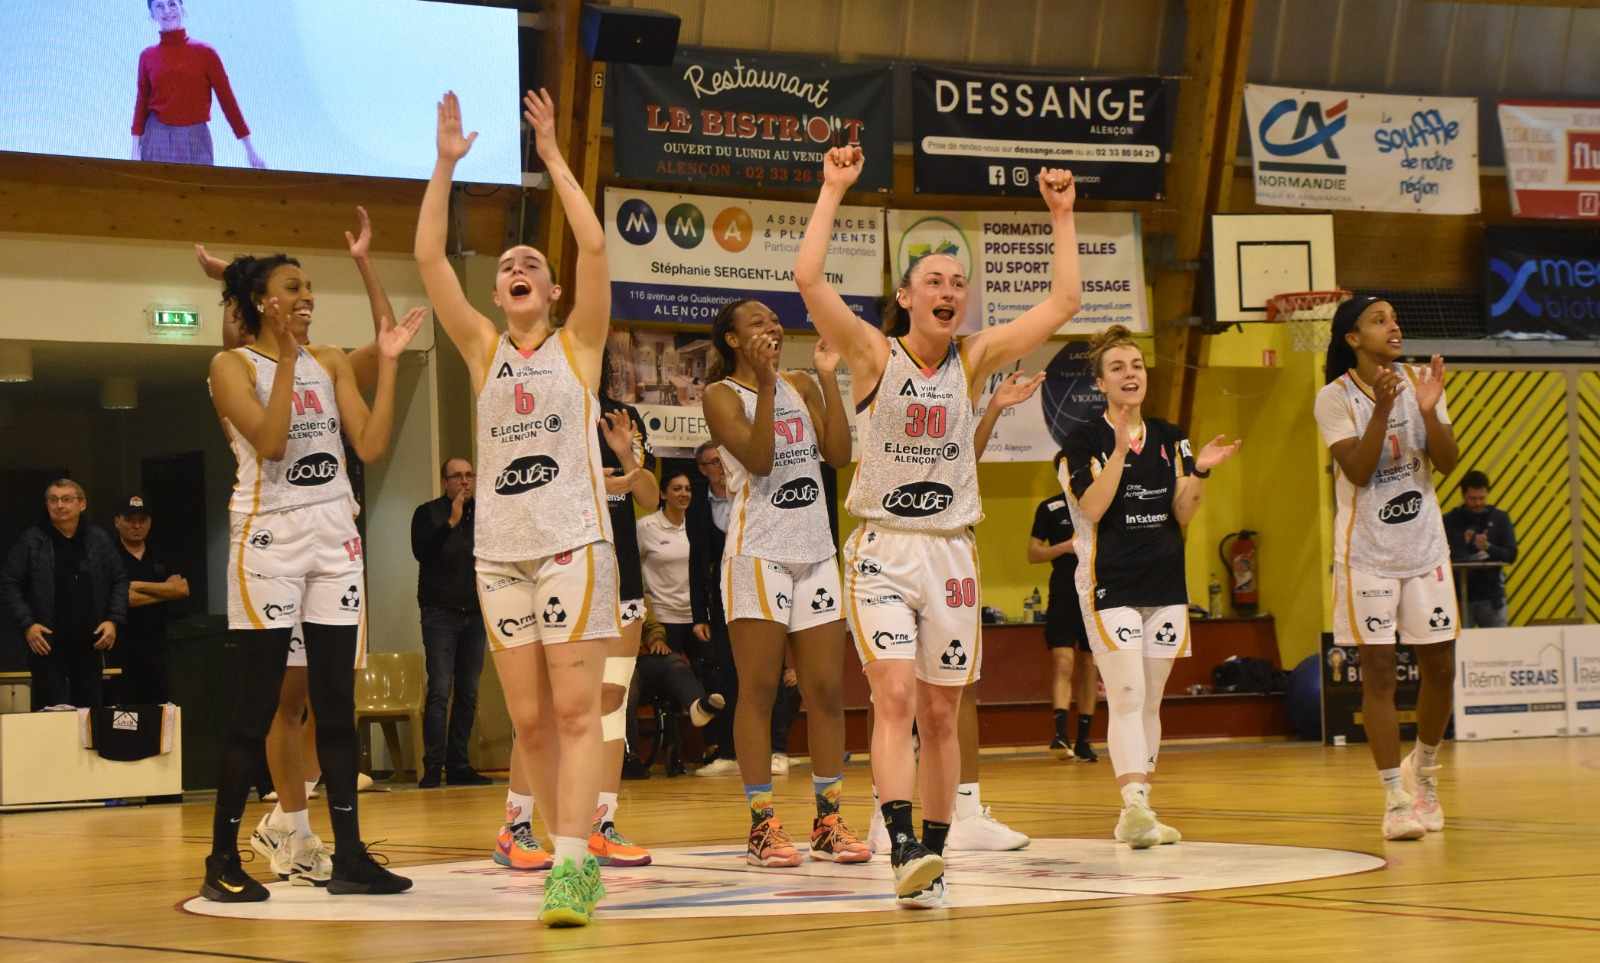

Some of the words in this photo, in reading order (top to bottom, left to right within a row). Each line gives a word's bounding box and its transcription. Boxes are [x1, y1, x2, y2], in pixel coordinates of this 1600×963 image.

[684, 59, 829, 108] Restaurant
[935, 79, 1145, 122] DESSANGE
[647, 104, 692, 134] LE
[1381, 112, 1392, 124] Le
[1090, 125, 1133, 136] ALENÇON
[1375, 109, 1459, 153] souffle
[664, 142, 712, 156] OUVERT
[716, 146, 732, 157] DU
[735, 147, 770, 160] LUNDI
[774, 151, 790, 161] AU
[793, 152, 825, 162] VEND
[1014, 146, 1073, 155] dessange.com
[1145, 150, 1154, 158] 21
[1400, 147, 1418, 169] de
[1421, 155, 1454, 171] notre
[656, 160, 732, 177] ALENÇON
[745, 167, 764, 180] 02
[1259, 175, 1346, 190] NORMANDIE
[1400, 177, 1439, 203] région
[625, 212, 650, 233] M
[674, 216, 697, 237] M
[724, 221, 742, 241] A
[767, 214, 876, 229] ASSUNCES
[984, 223, 1053, 236] FORMATIO
[764, 228, 772, 238] &
[781, 230, 876, 244] PLAMENTS
[984, 242, 1117, 255] PROFESSIOELLES
[651, 261, 711, 276] Stéphanie
[986, 261, 1002, 274] DU
[1006, 261, 1050, 274] SPORT
[986, 281, 1010, 293] PAR
[1014, 280, 1131, 293] L'APPISSAGE
[630, 290, 645, 300] 116
[646, 293, 676, 301] avenue
[677, 294, 688, 302] de
[654, 304, 719, 319] ALENÇON
[514, 383, 535, 415] 6
[905, 404, 946, 438] 30
[774, 417, 804, 444] 97
[884, 442, 942, 456] E.Leclerc
[895, 455, 936, 466] ALENÇON
[885, 488, 953, 510] BOUBET
[946, 577, 976, 608] 30
[1510, 669, 1559, 686] SERAIS
